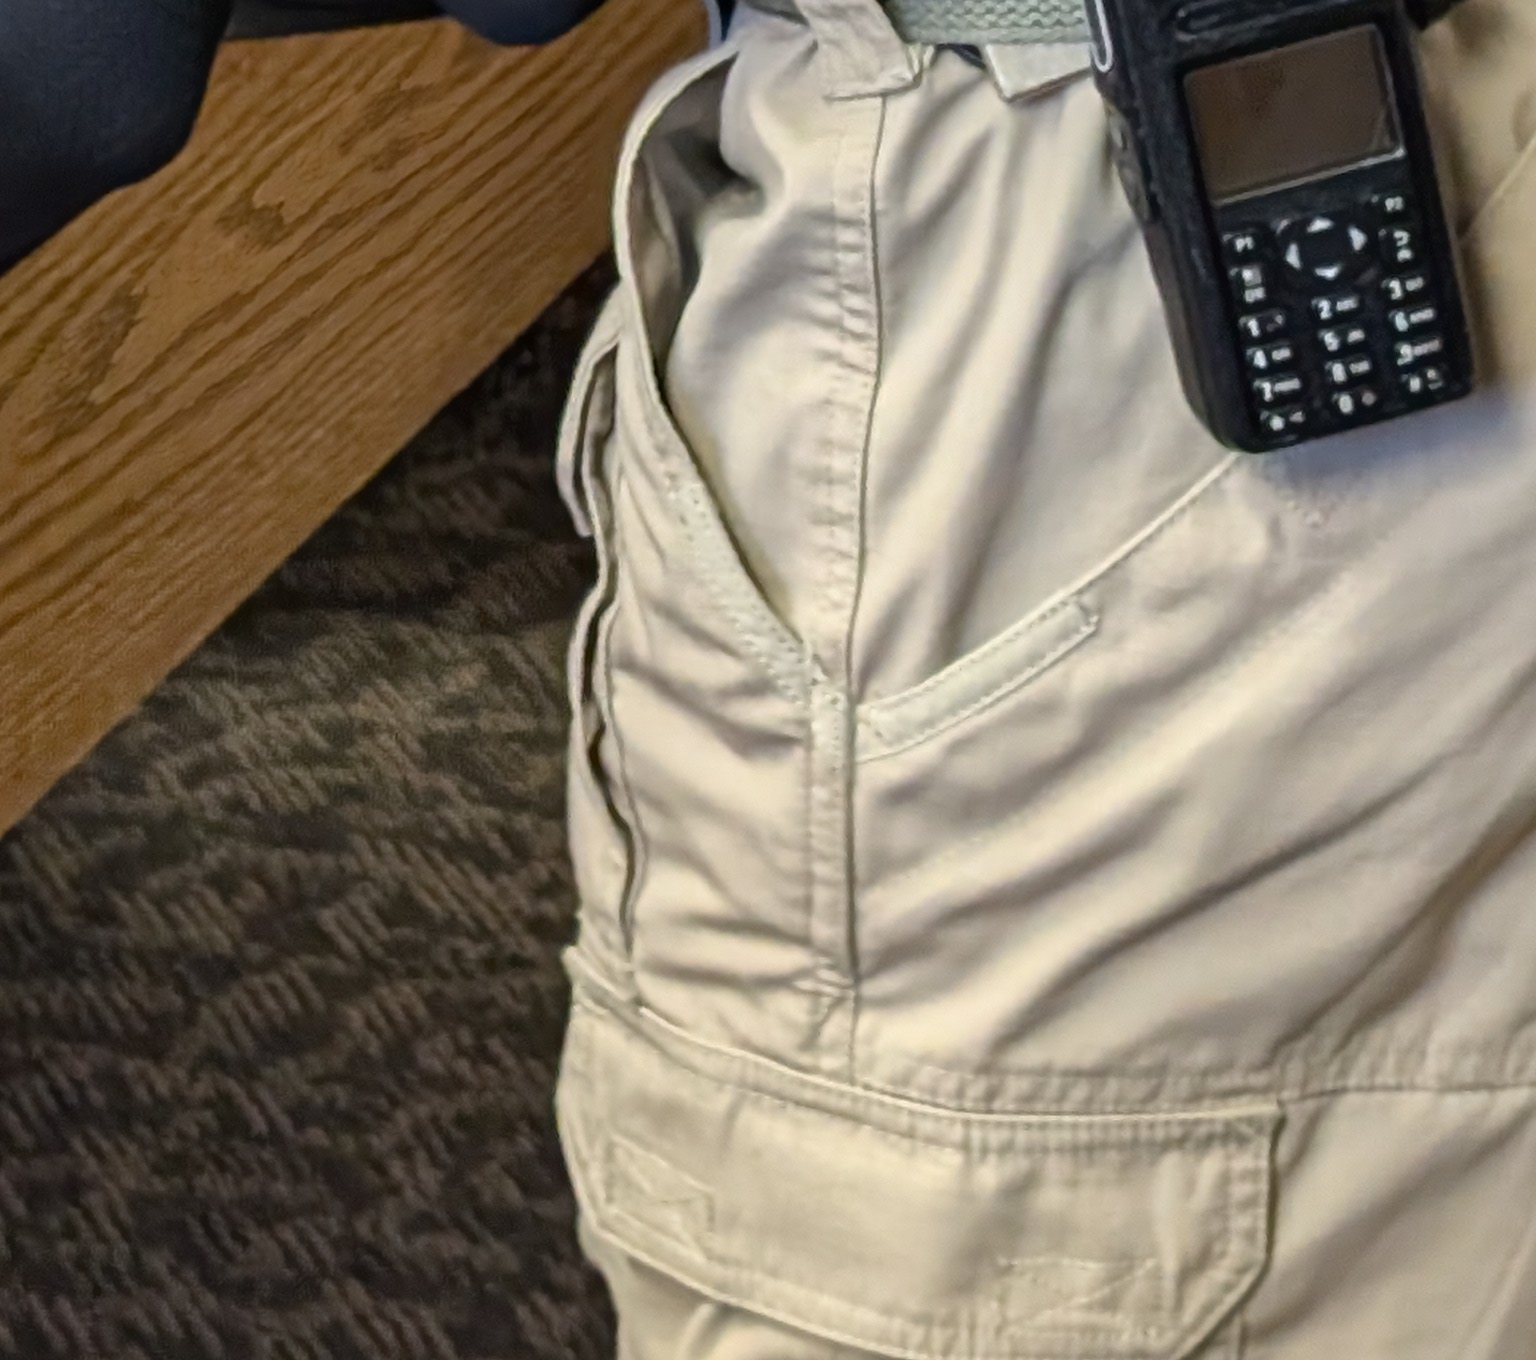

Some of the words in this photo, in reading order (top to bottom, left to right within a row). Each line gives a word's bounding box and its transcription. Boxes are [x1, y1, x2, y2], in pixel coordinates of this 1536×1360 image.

[1317, 299, 1332, 320] 2
[1246, 318, 1260, 338] 1
[1323, 331, 1339, 352] 5
[1253, 350, 1267, 369] 4
